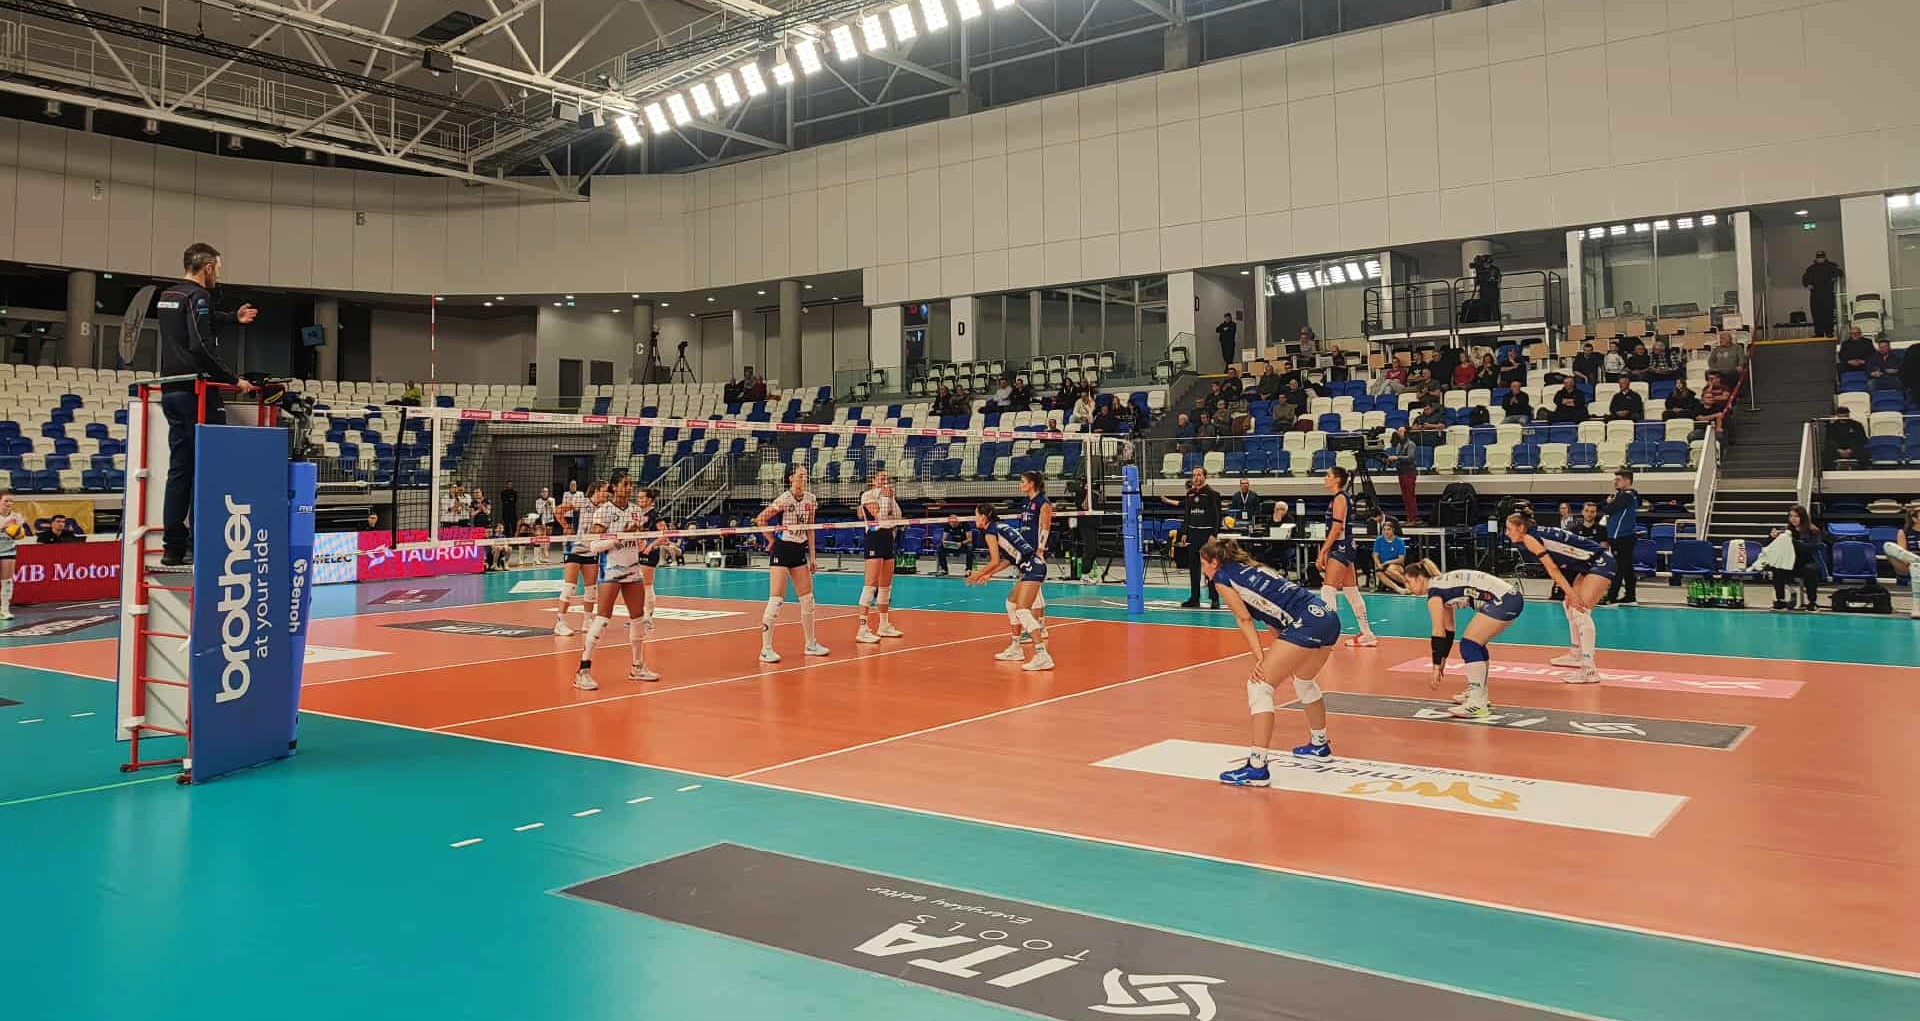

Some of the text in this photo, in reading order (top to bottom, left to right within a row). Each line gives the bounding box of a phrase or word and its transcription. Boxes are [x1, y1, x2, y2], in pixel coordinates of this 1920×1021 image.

[216, 494, 252, 704] brother
[253, 528, 272, 658] at your side
[288, 575, 305, 633] Senoh
[1277, 761, 1412, 781] mielec
[866, 885, 1033, 924] Everyday better
[853, 922, 1080, 988] ITA
[908, 914, 1091, 961] TOOLS
